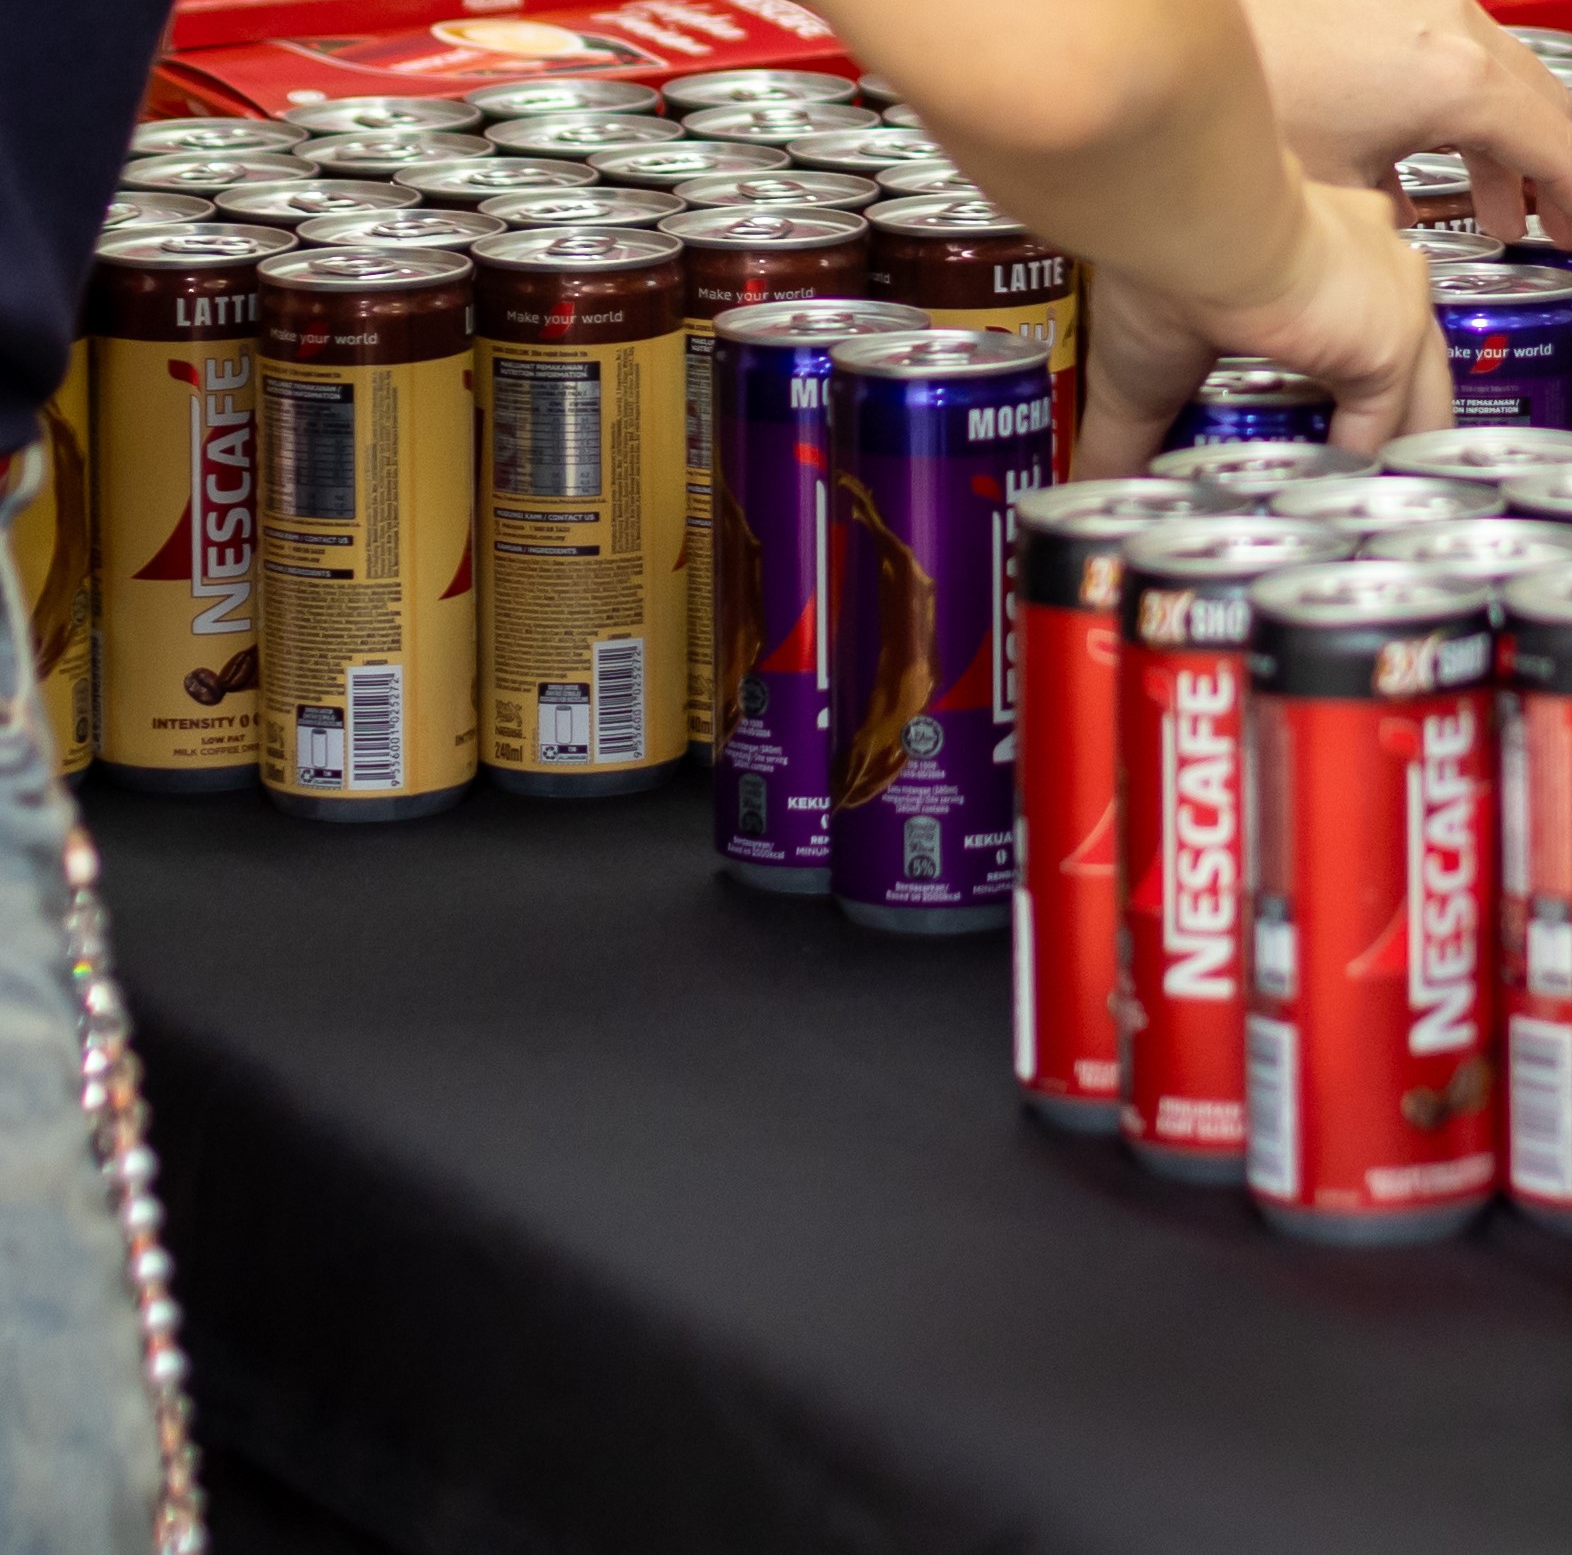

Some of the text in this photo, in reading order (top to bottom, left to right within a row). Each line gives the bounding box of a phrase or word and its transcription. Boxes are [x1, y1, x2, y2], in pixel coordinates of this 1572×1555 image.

[993, 256, 1064, 293] LATTE
[698, 287, 815, 304] Make your world
[507, 310, 623, 325] Make your world
[270, 327, 379, 345] Make your world
[1447, 344, 1552, 362] ake your world
[1190, 594, 1250, 643] SHO
[152, 716, 235, 730] INTENSITY
[201, 734, 246, 745] LOW FAT
[494, 741, 523, 762] 240ml
[912, 859, 935, 875] 5%
